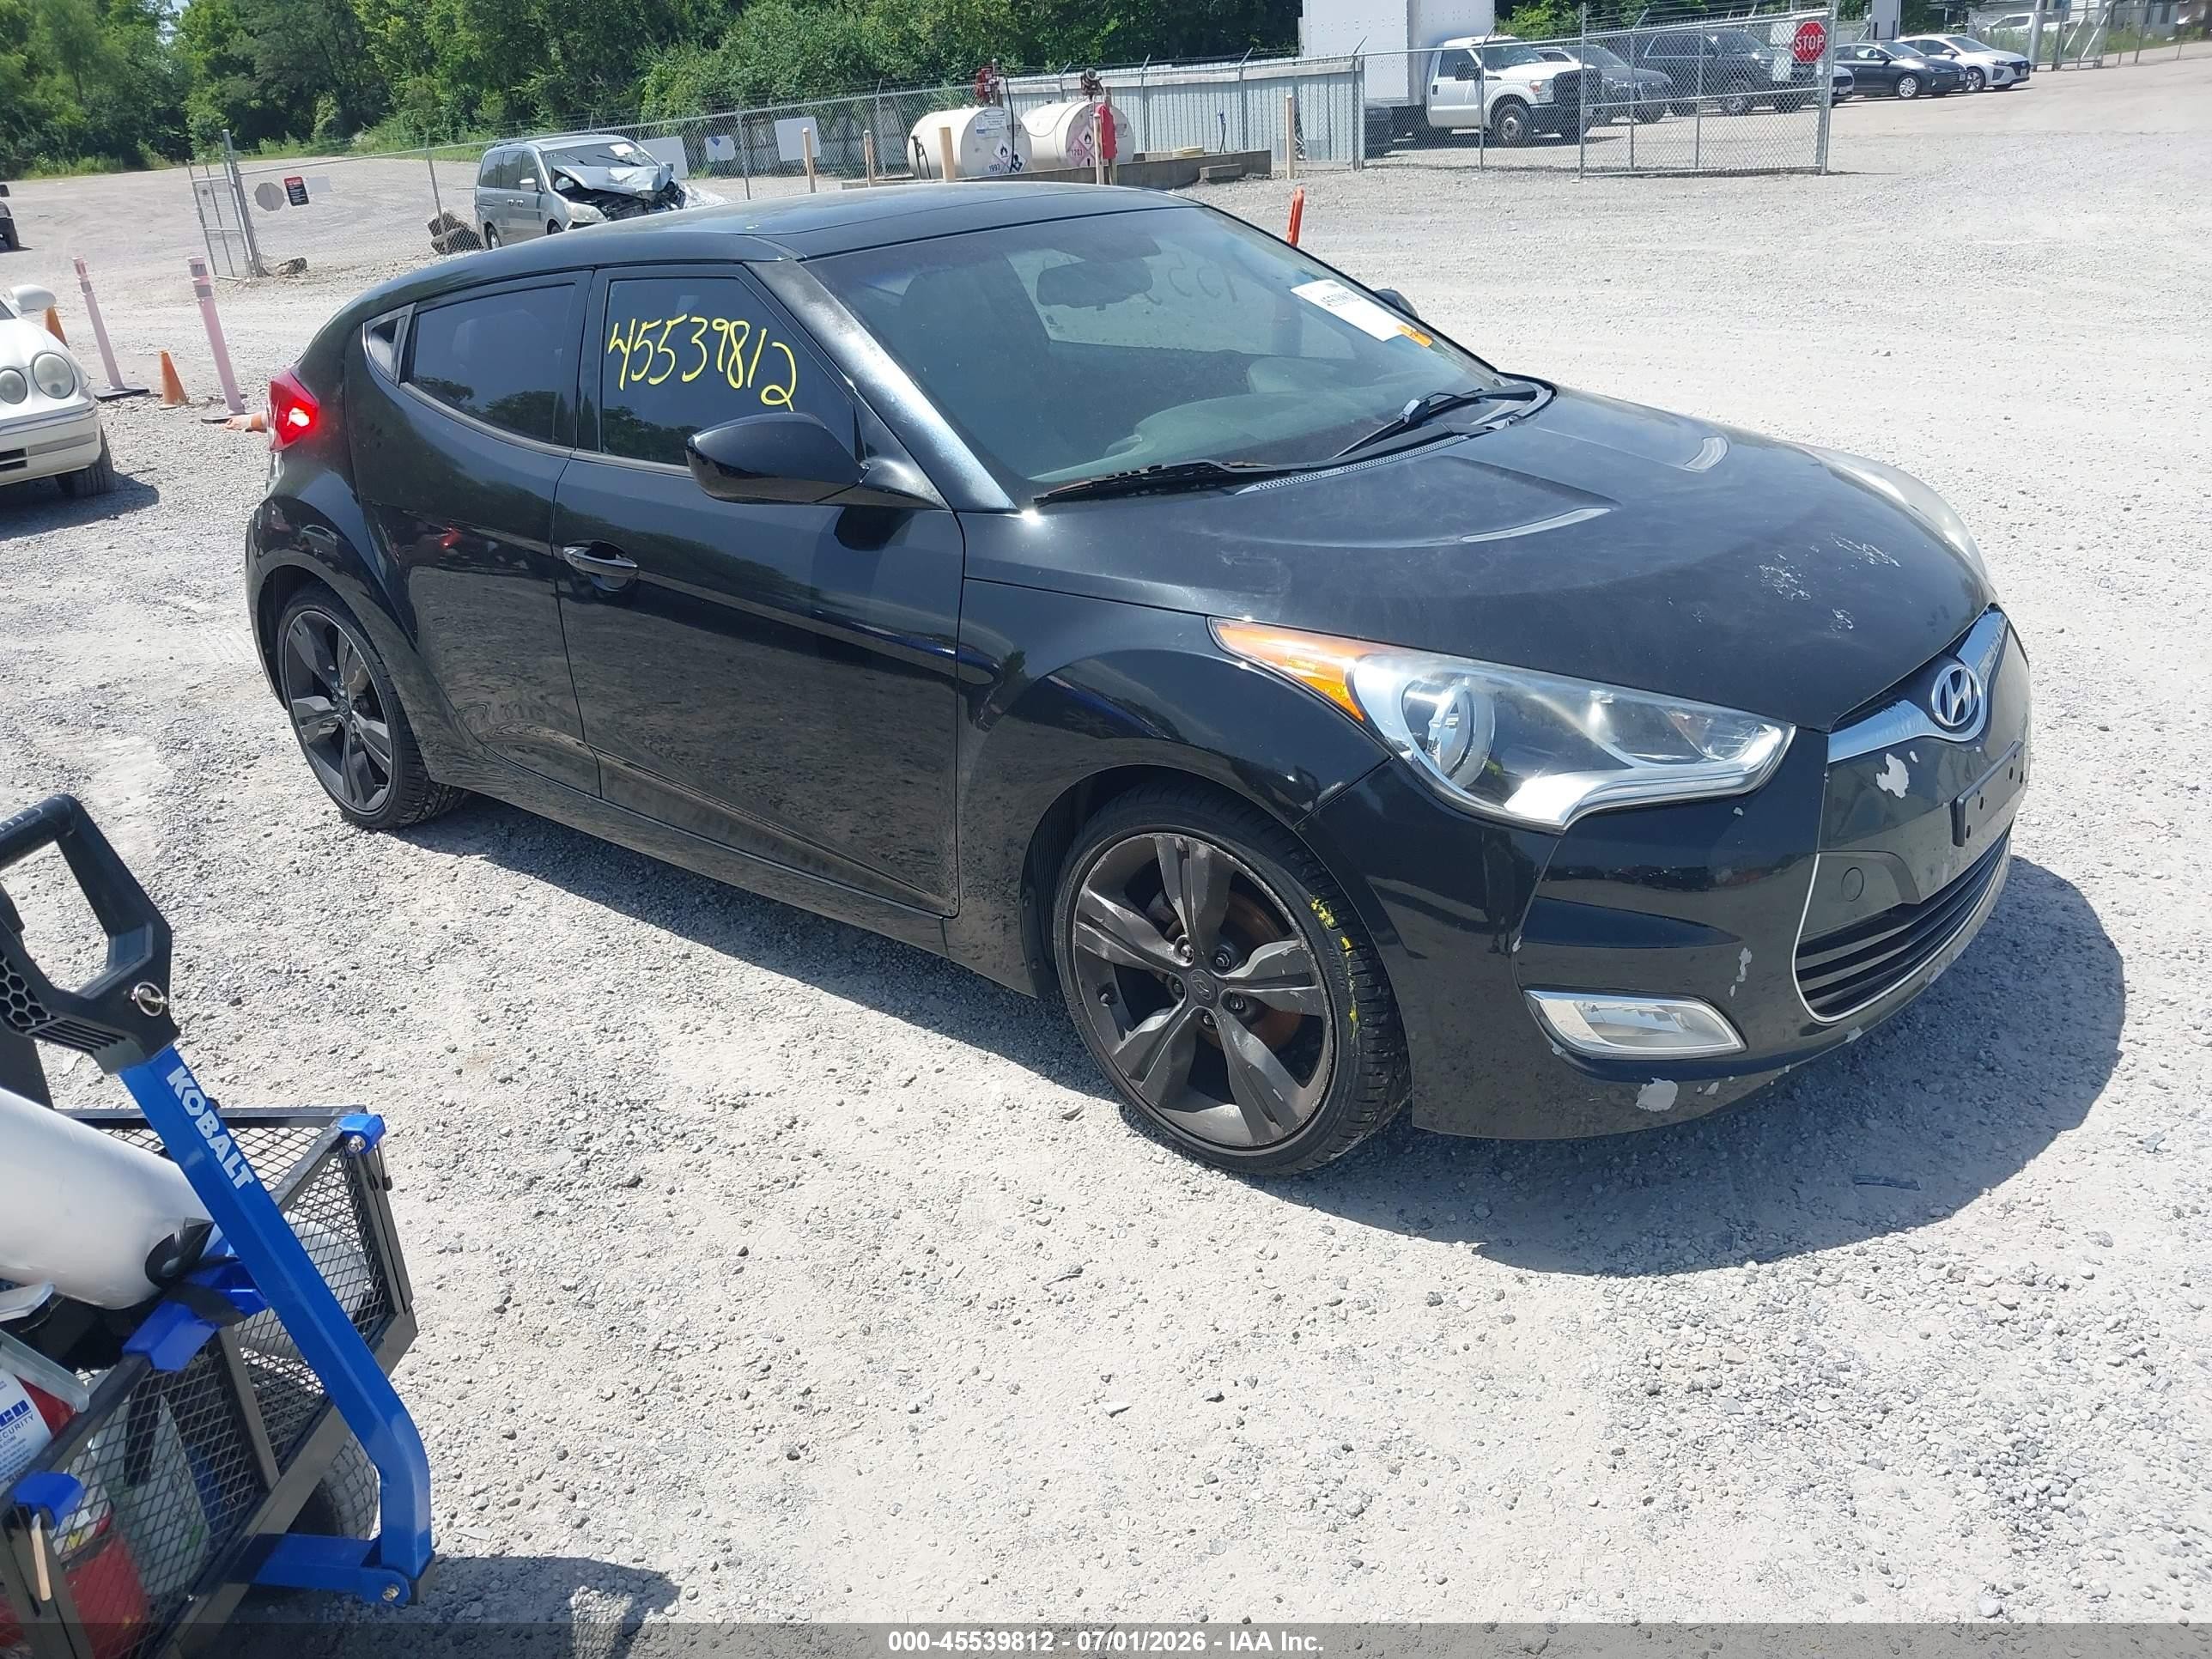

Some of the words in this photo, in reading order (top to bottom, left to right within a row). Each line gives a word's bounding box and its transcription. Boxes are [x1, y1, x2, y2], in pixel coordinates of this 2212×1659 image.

[1795, 35, 1824, 51] STOP
[607, 313, 798, 412] 45539812
[167, 1066, 255, 1189] KOBALT
